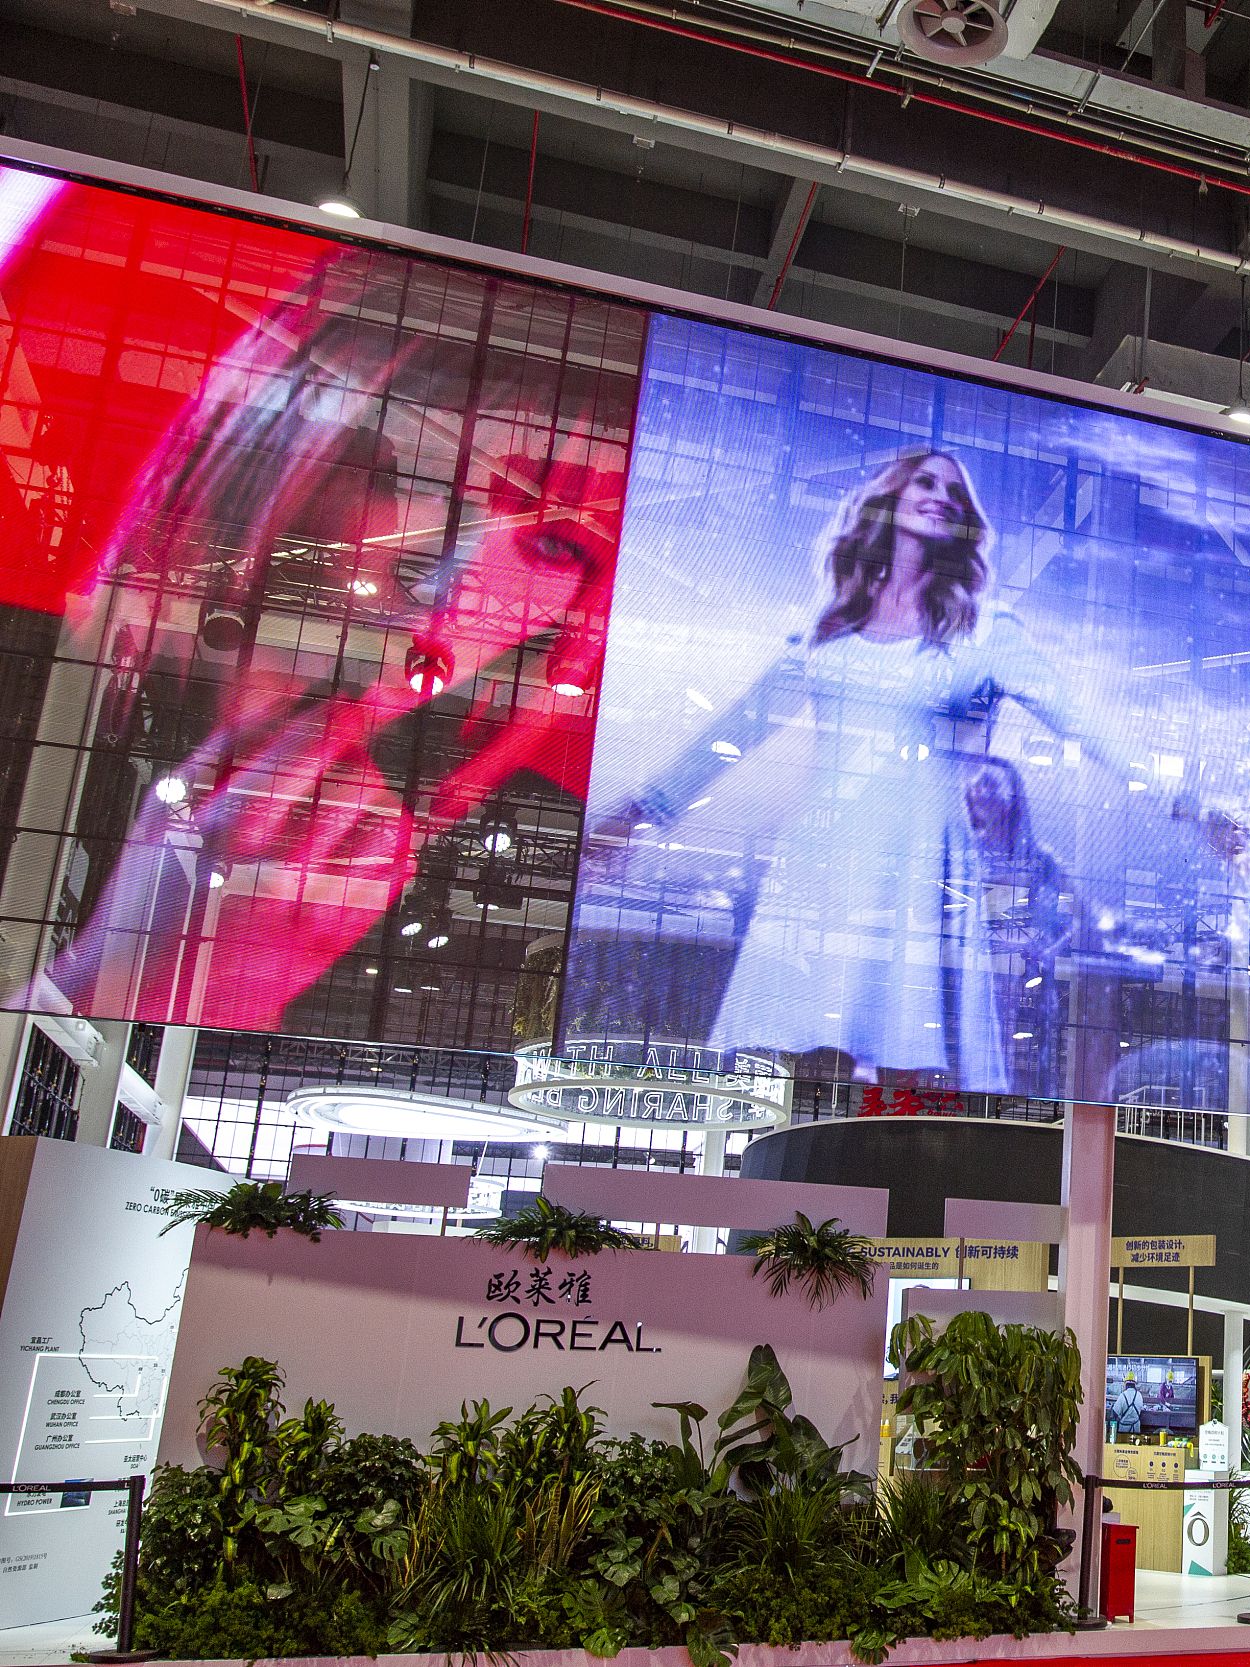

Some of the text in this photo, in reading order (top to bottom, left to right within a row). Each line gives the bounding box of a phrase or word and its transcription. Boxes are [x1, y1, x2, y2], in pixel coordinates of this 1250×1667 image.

[637, 1048, 710, 1084] ALL
[125, 1201, 142, 1211] ZERO
[143, 1204, 169, 1217] CARBON
[861, 1246, 950, 1259] SUSTAINABLY
[1131, 1252, 1180, 1262] 减少环境足迹
[486, 1266, 593, 1307] 欧莱雅
[455, 1311, 663, 1352] L'ORÉAL
